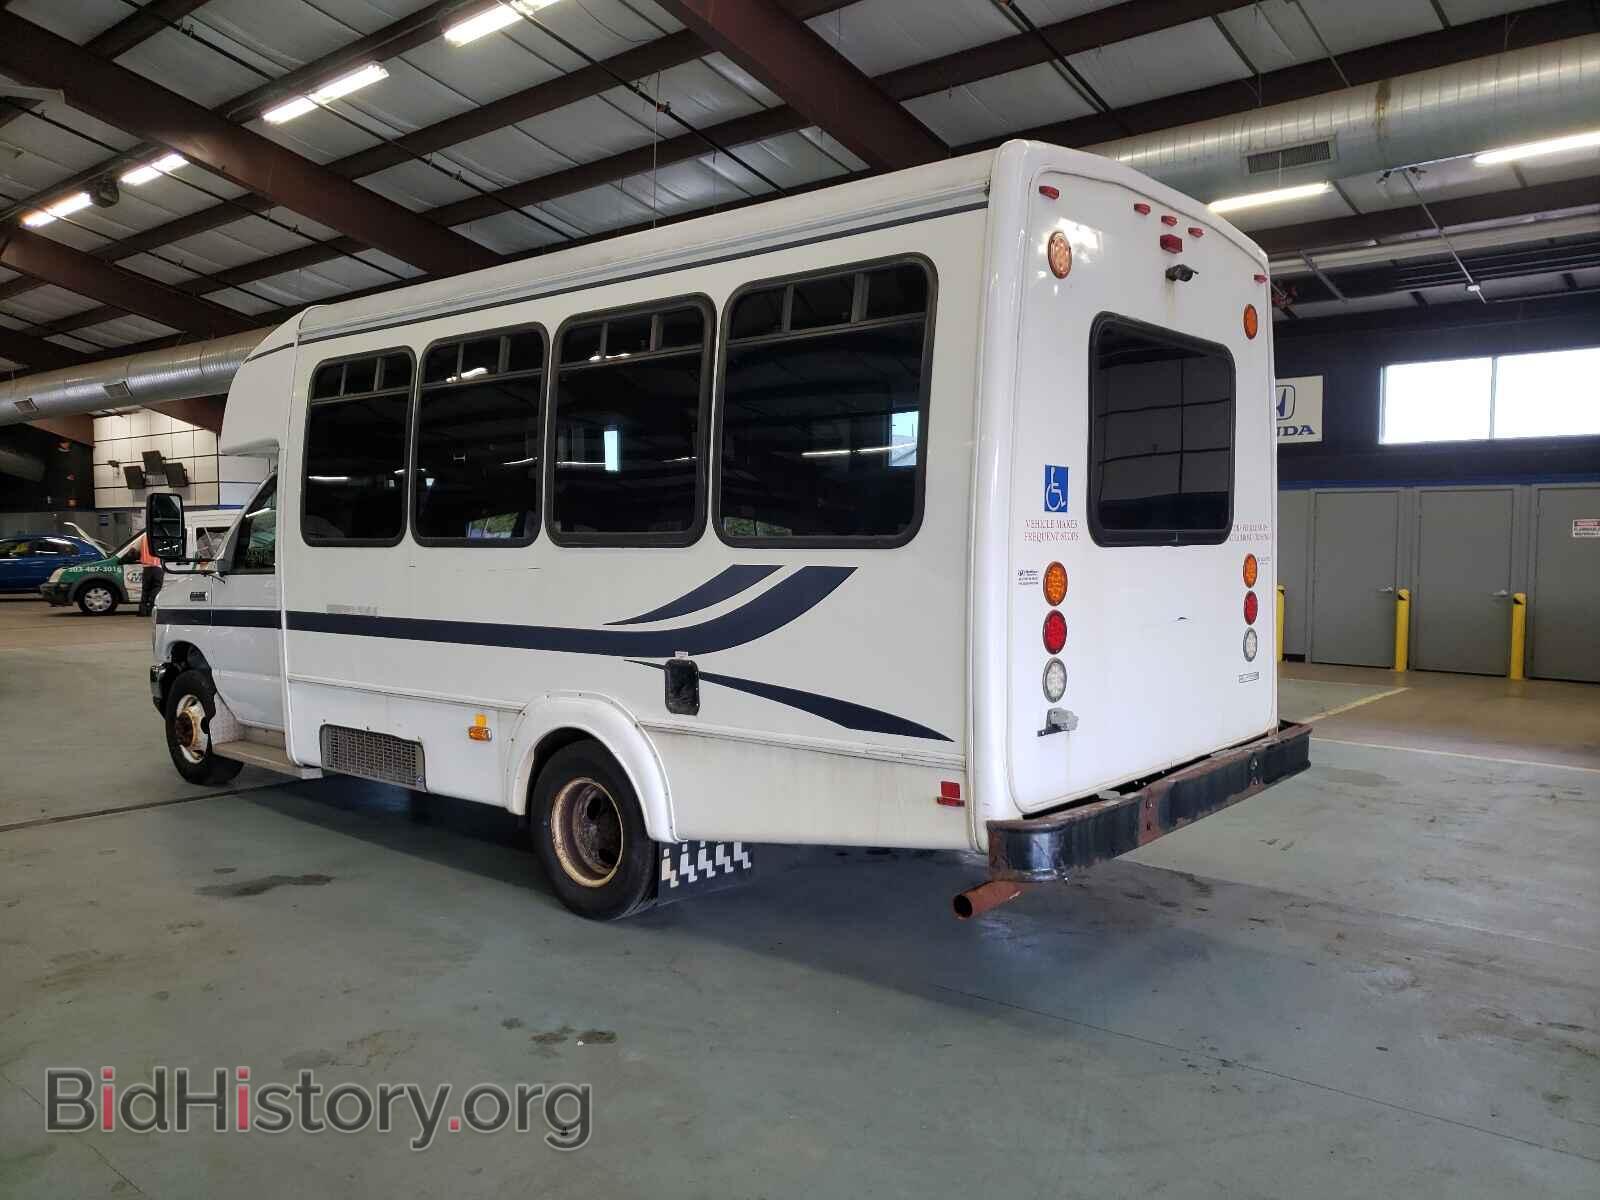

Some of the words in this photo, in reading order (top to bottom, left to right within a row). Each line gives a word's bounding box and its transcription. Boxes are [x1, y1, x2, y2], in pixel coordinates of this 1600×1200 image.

[1025, 519, 1055, 529] VEHICLE
[1056, 519, 1080, 529] MAKES
[1024, 531, 1059, 542] FREQUENT
[1059, 531, 1080, 541] STOPS
